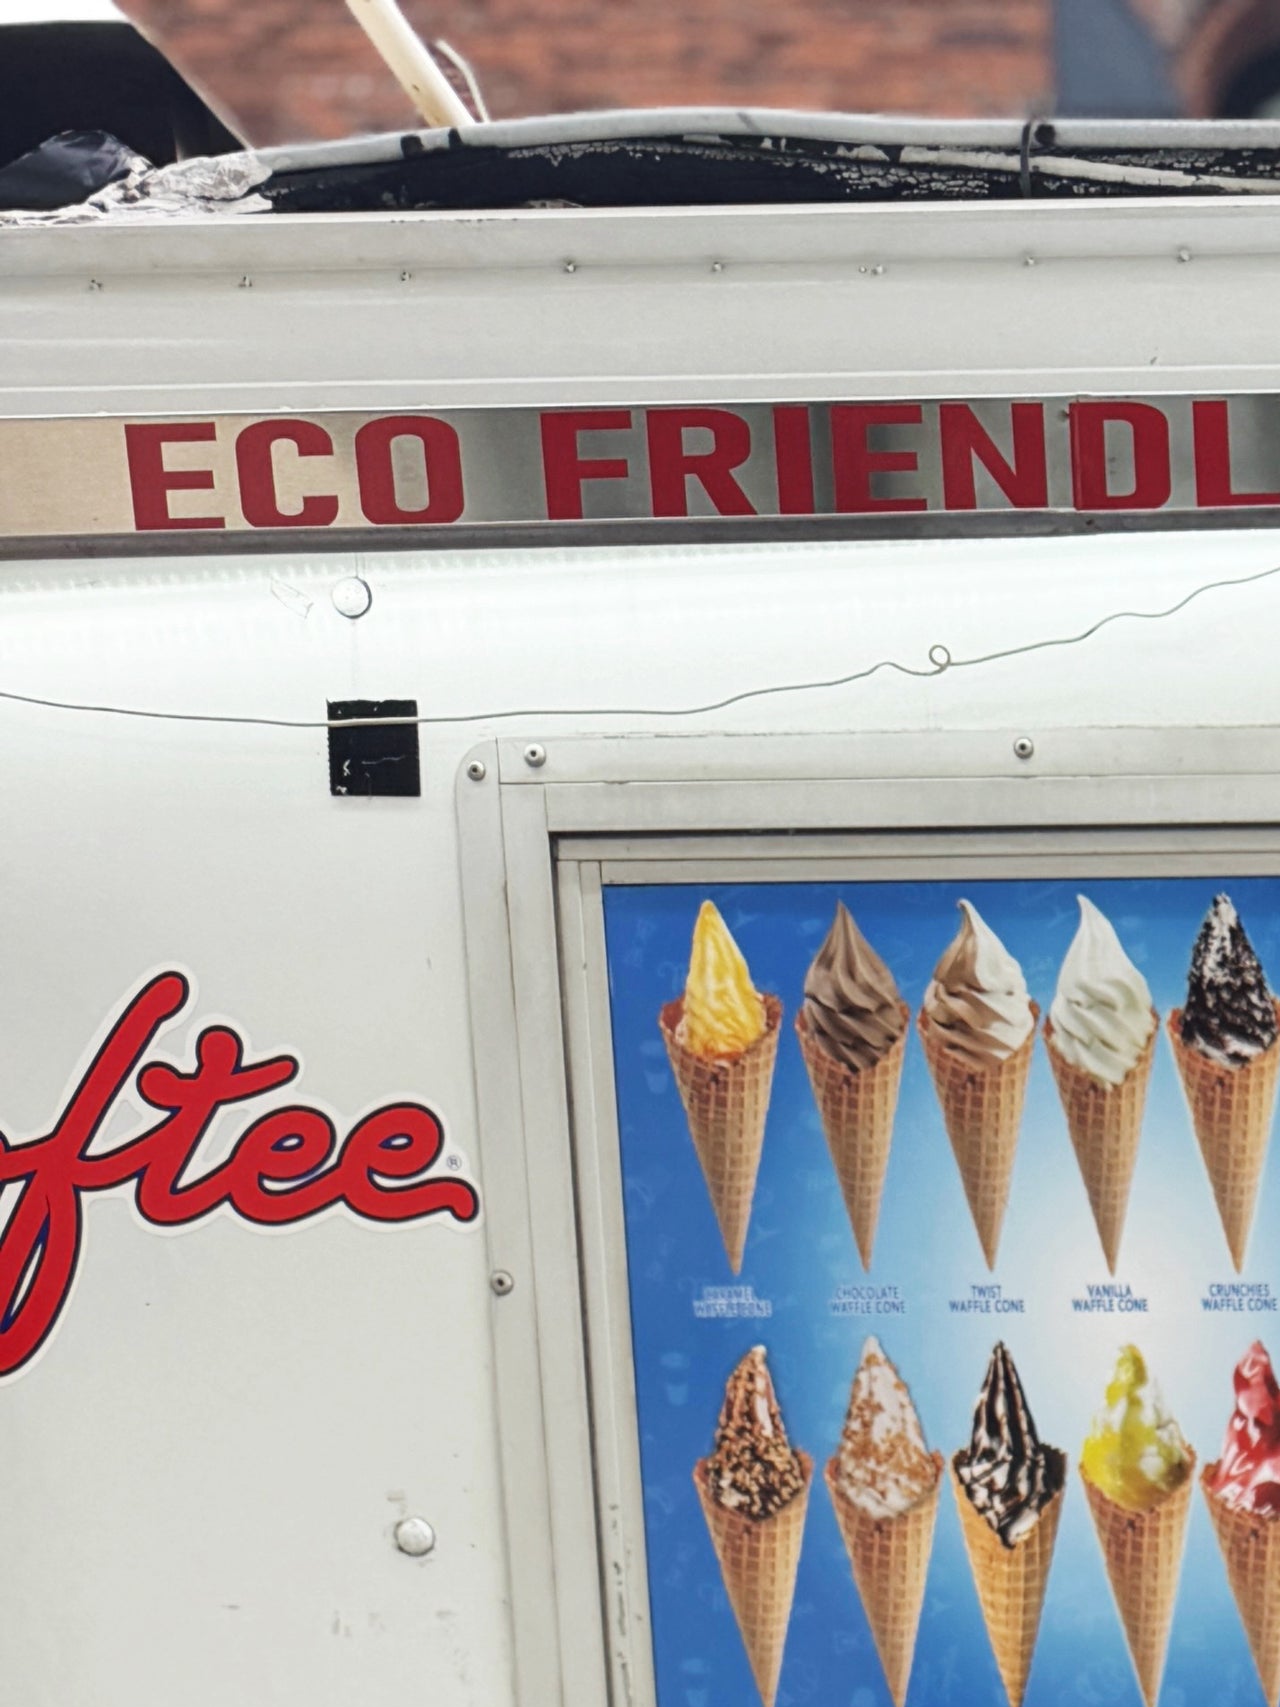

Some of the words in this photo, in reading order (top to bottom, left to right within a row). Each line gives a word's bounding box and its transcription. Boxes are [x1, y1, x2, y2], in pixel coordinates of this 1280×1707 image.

[123, 414, 466, 530] ECO
[0, 970, 480, 1377] ftee
[835, 1285, 899, 1299] CHOCOLATE
[971, 1285, 1002, 1298] TWIST
[1086, 1285, 1132, 1298] VANILLA
[1209, 1284, 1270, 1297] CRUNCHIES
[832, 1301, 872, 1314] WAFFLE
[876, 1301, 906, 1314] CONE
[949, 1300, 991, 1313] WAFFLE
[994, 1300, 1025, 1313] CONE
[1072, 1299, 1115, 1312] WAFFLE
[1118, 1299, 1148, 1312] CONE
[1202, 1298, 1244, 1311] WAFFLE
[1247, 1298, 1278, 1311] CONE
